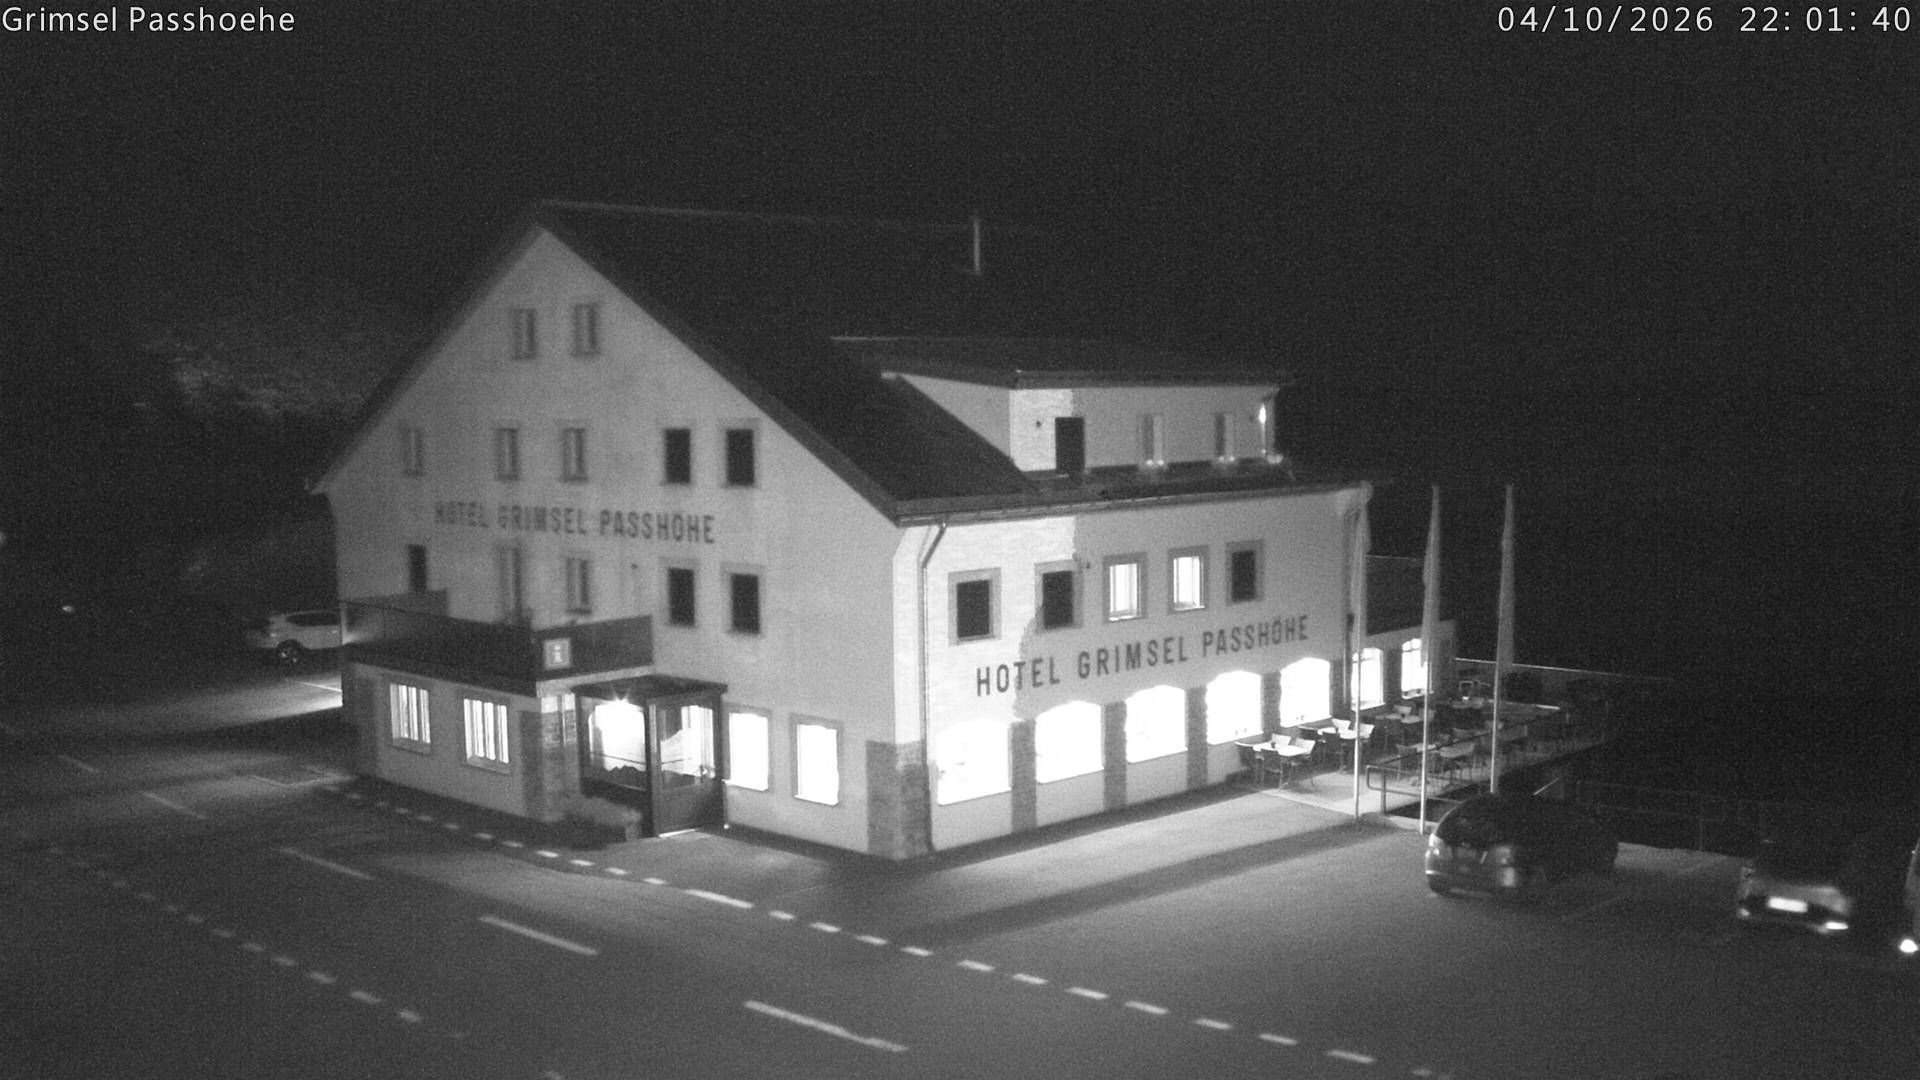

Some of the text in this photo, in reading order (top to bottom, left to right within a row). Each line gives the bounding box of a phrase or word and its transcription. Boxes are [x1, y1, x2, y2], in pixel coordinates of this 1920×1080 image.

[434, 500, 490, 528] HOTEL
[498, 503, 586, 534] GRIMSEL
[976, 657, 1061, 697] HOTEL
[1077, 635, 1189, 680] GRIMSEL
